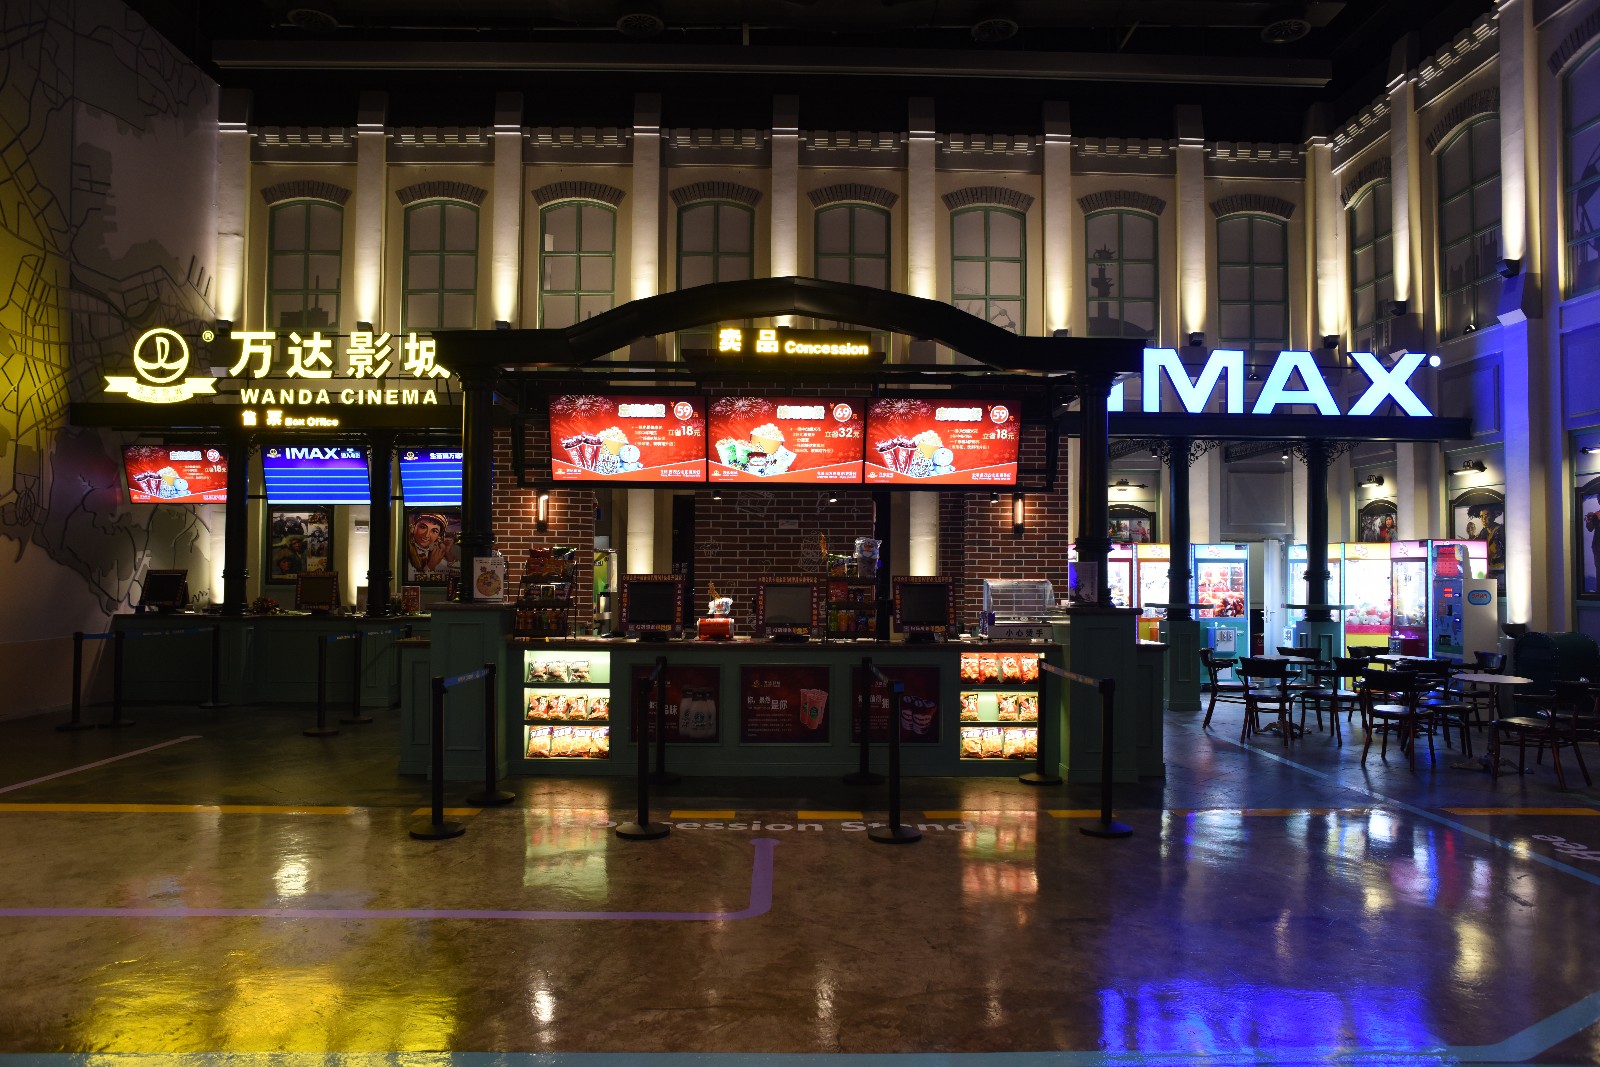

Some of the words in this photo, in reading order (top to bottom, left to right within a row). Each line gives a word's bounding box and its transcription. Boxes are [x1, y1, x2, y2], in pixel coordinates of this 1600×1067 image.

[784, 340, 869, 355] Concession
[240, 388, 330, 405] WANDA
[340, 388, 438, 405] CINEMA
[677, 405, 690, 417] 59
[835, 407, 850, 418] 69
[993, 409, 1007, 420] 59
[284, 417, 306, 426] Box
[306, 416, 339, 426] Office
[285, 447, 339, 460] IMAX
[1005, 628, 1044, 638] 小心烫手
